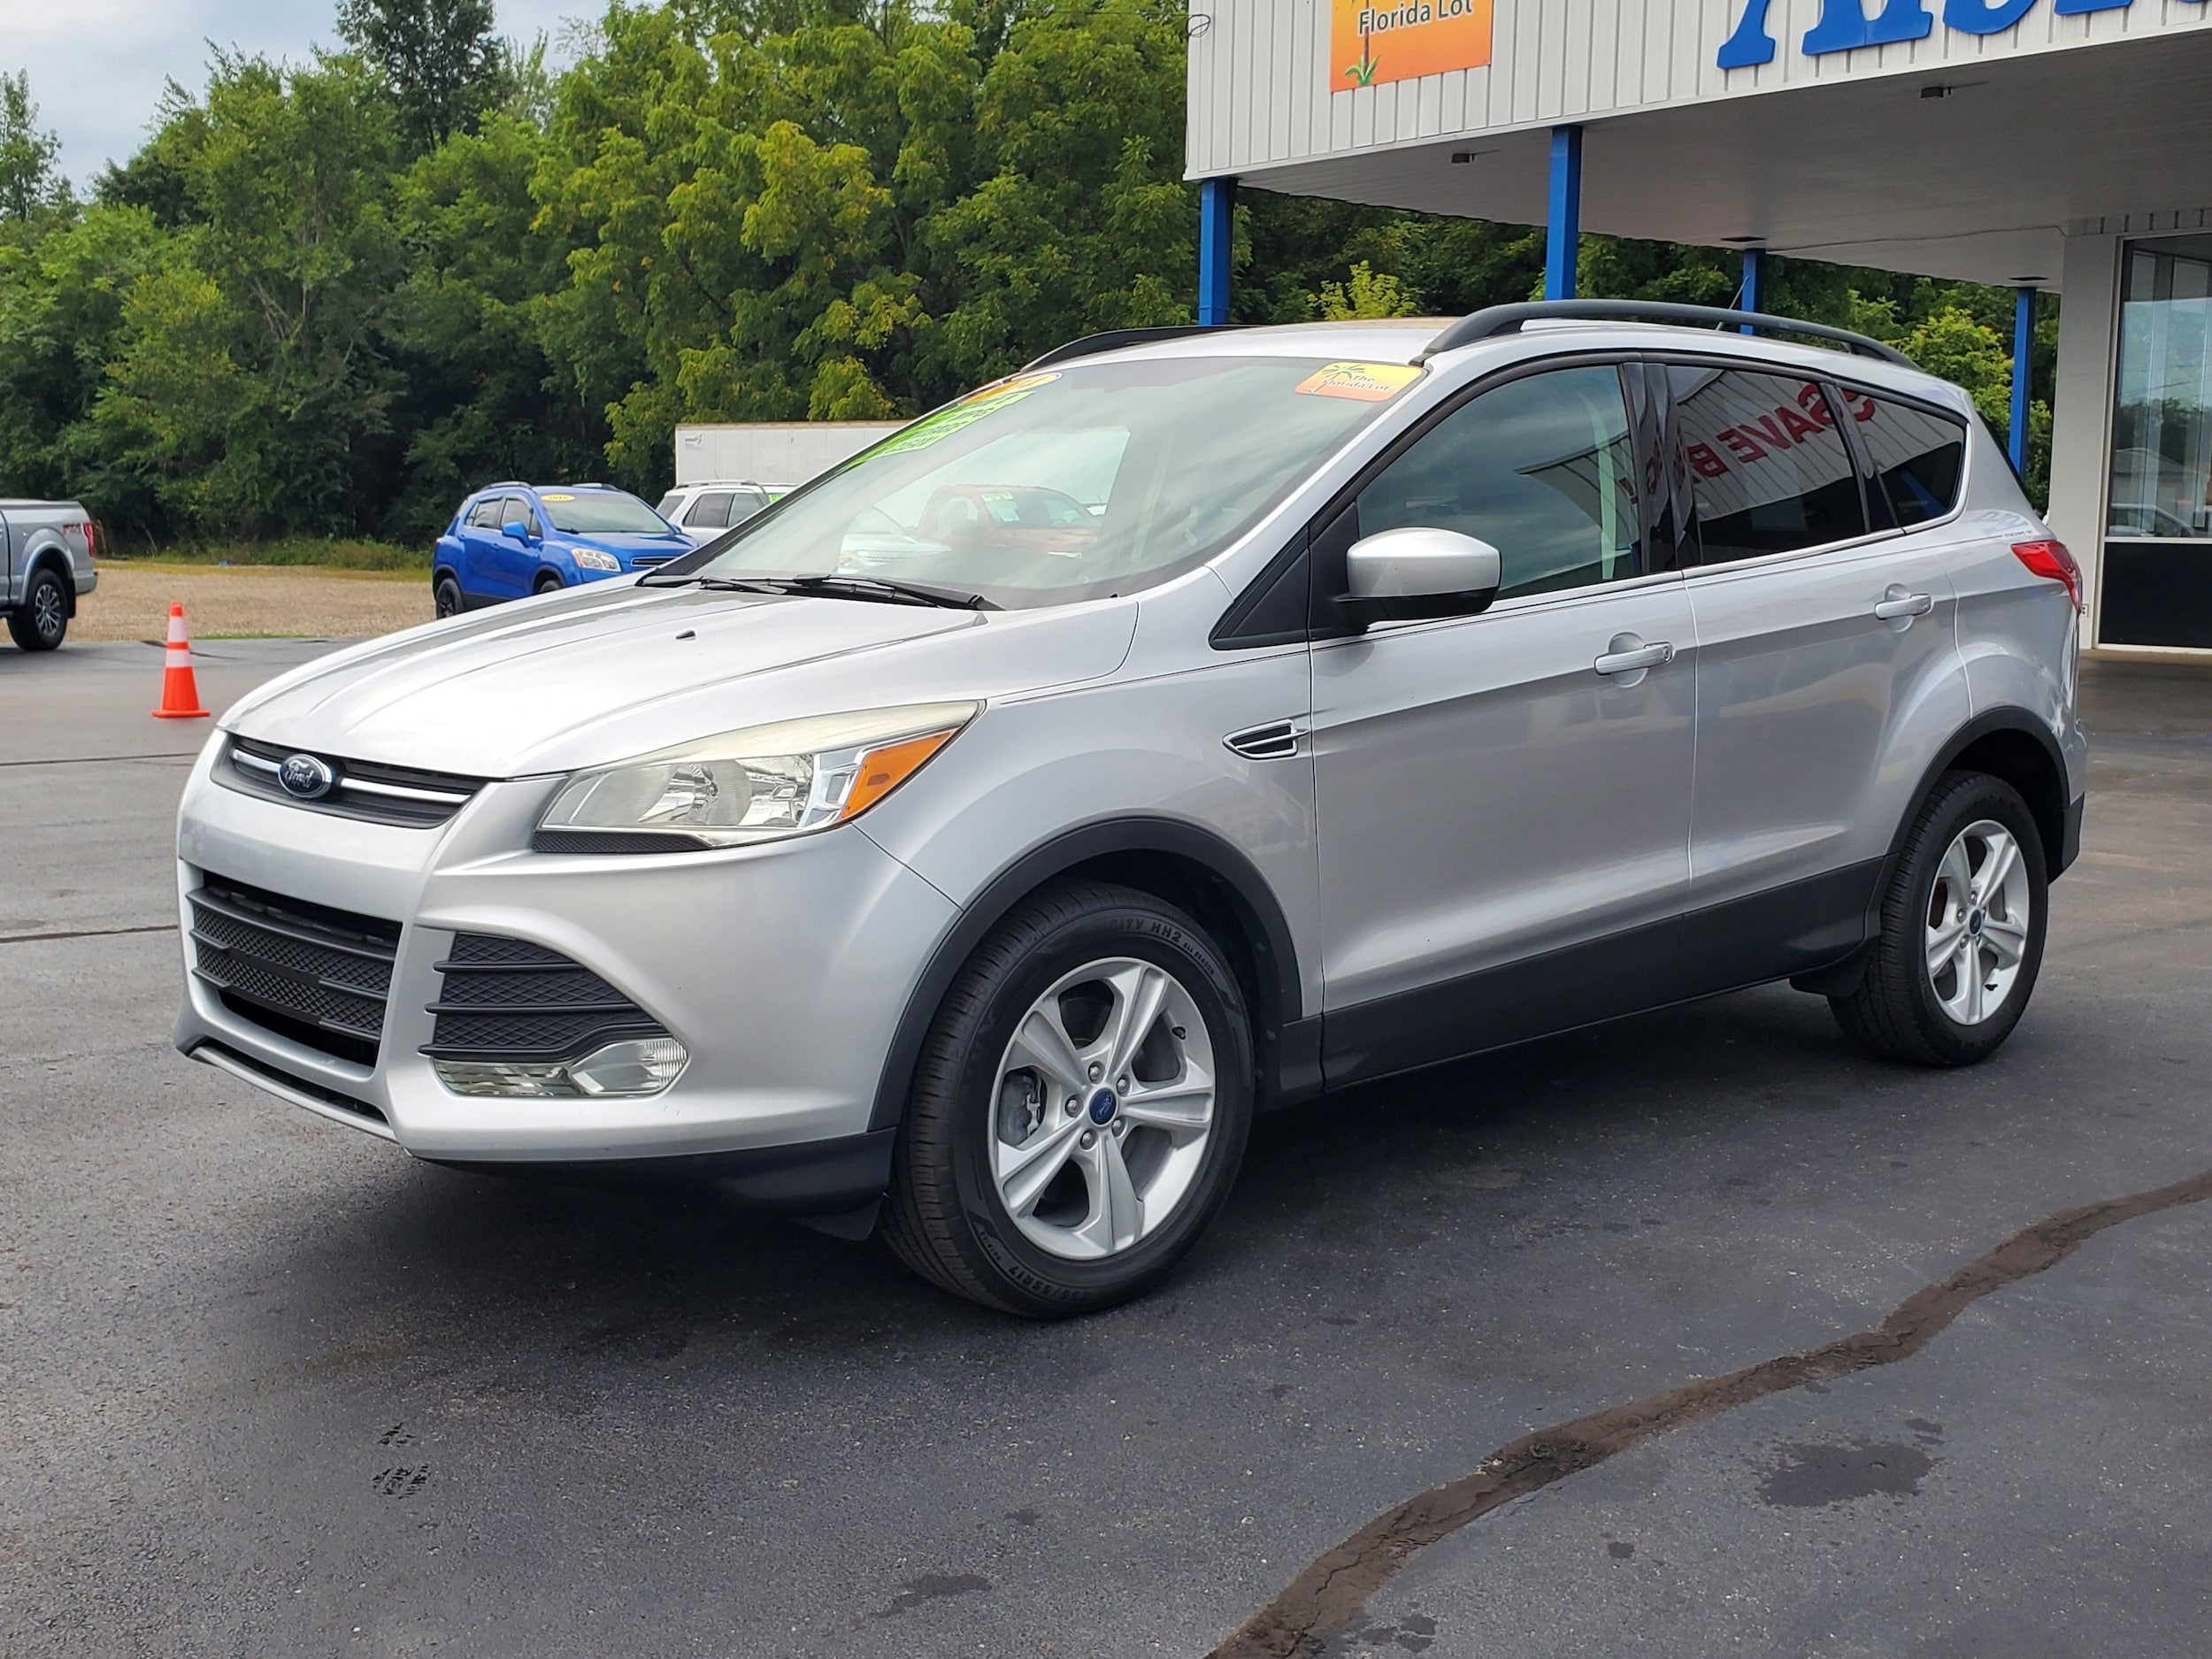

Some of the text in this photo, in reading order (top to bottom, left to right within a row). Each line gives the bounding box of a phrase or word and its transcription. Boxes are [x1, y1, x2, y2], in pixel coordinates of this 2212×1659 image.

[1358, 0, 1472, 35] Florida Lot
[285, 759, 315, 789] Ford
